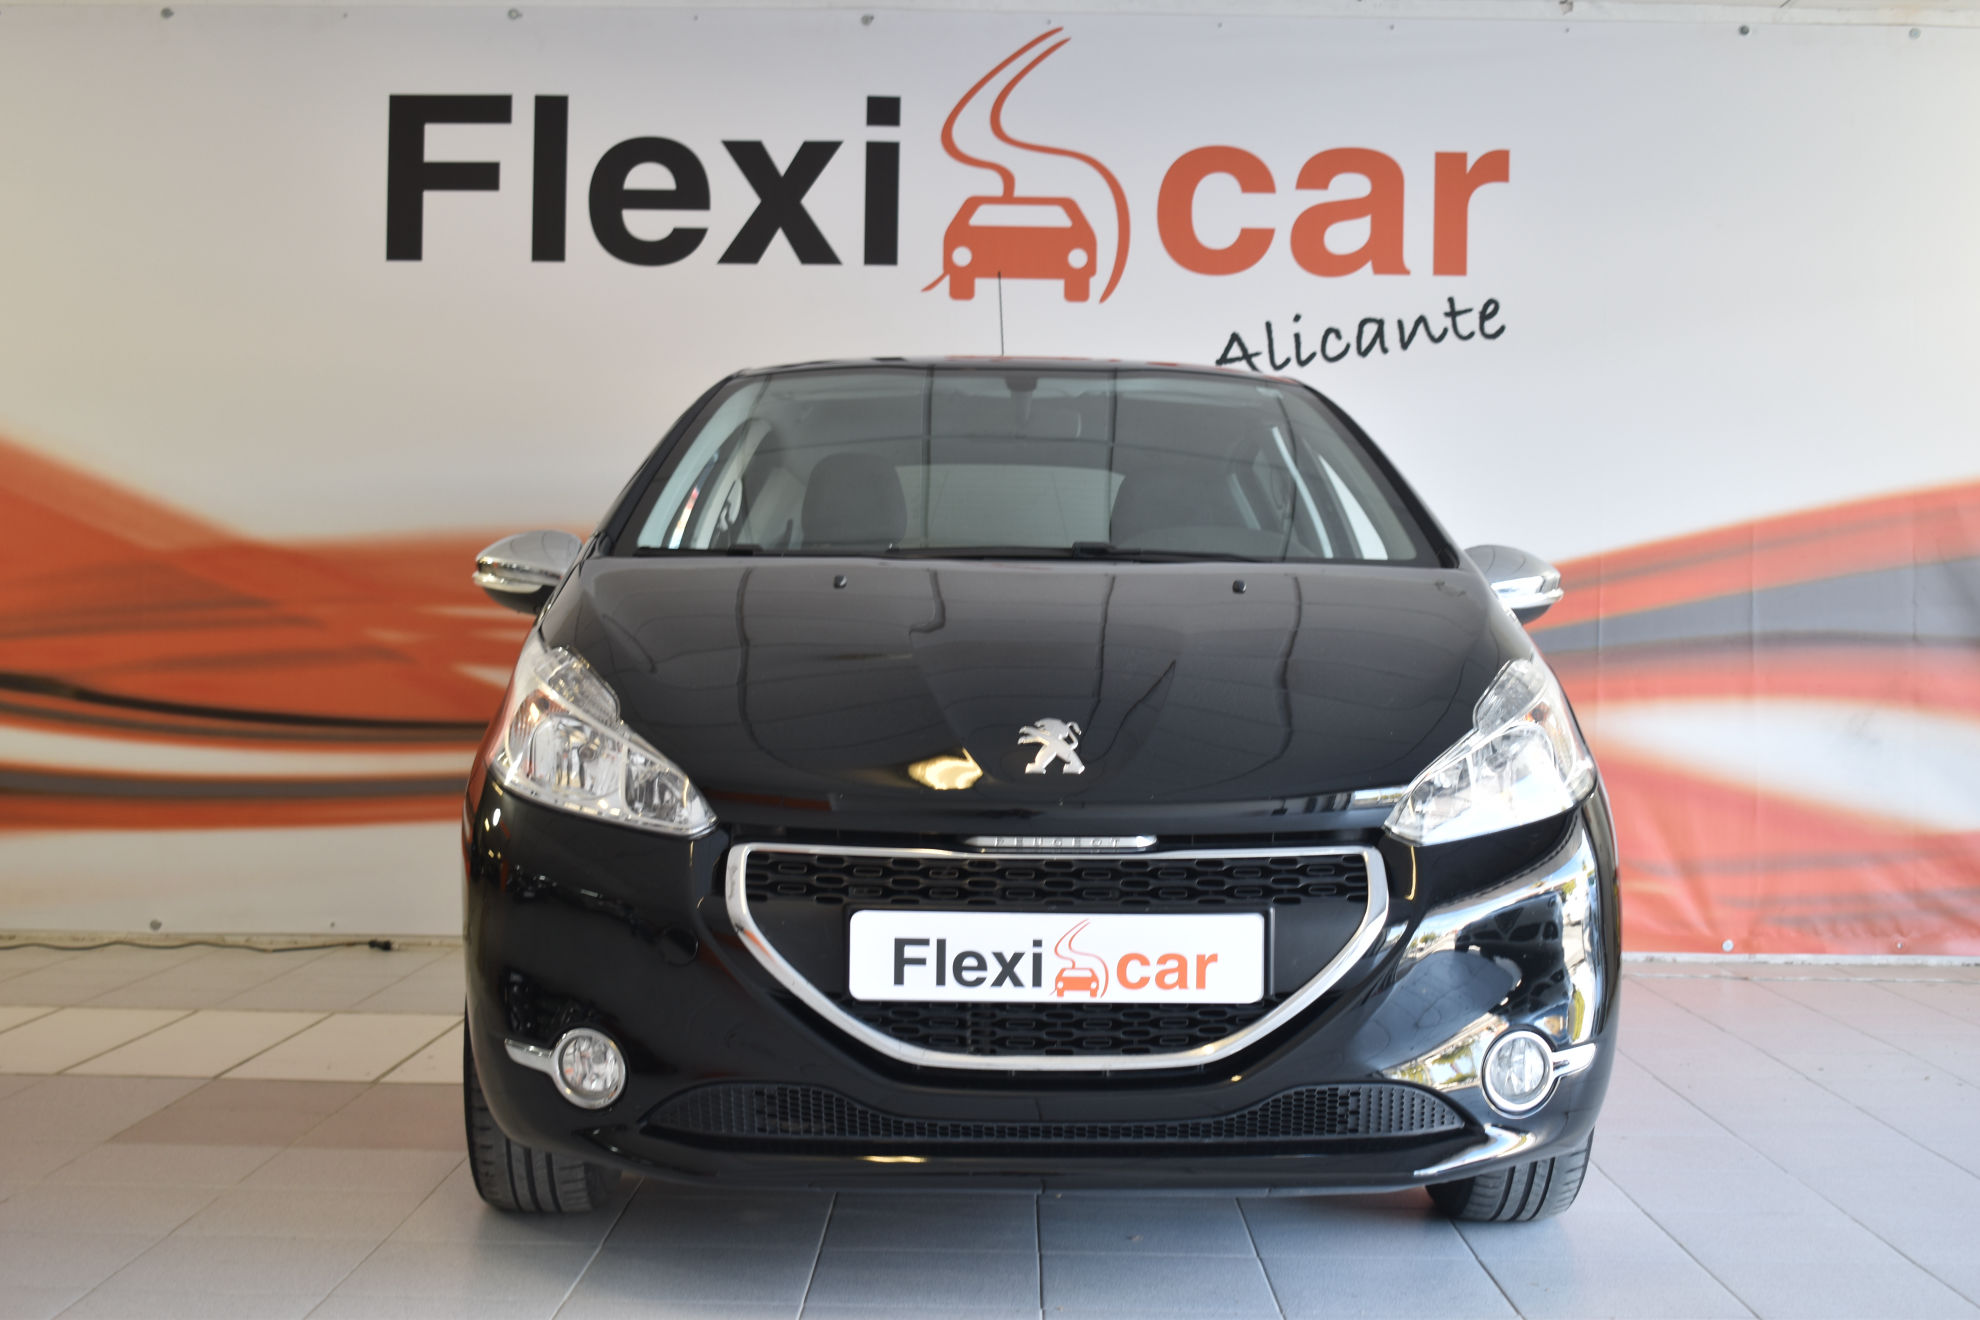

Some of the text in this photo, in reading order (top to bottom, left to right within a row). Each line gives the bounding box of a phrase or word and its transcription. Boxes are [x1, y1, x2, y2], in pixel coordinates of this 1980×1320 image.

[386, 94, 1510, 278] Flexi car
[1216, 296, 1506, 373] Alicante
[893, 937, 1218, 991] Flexi car
